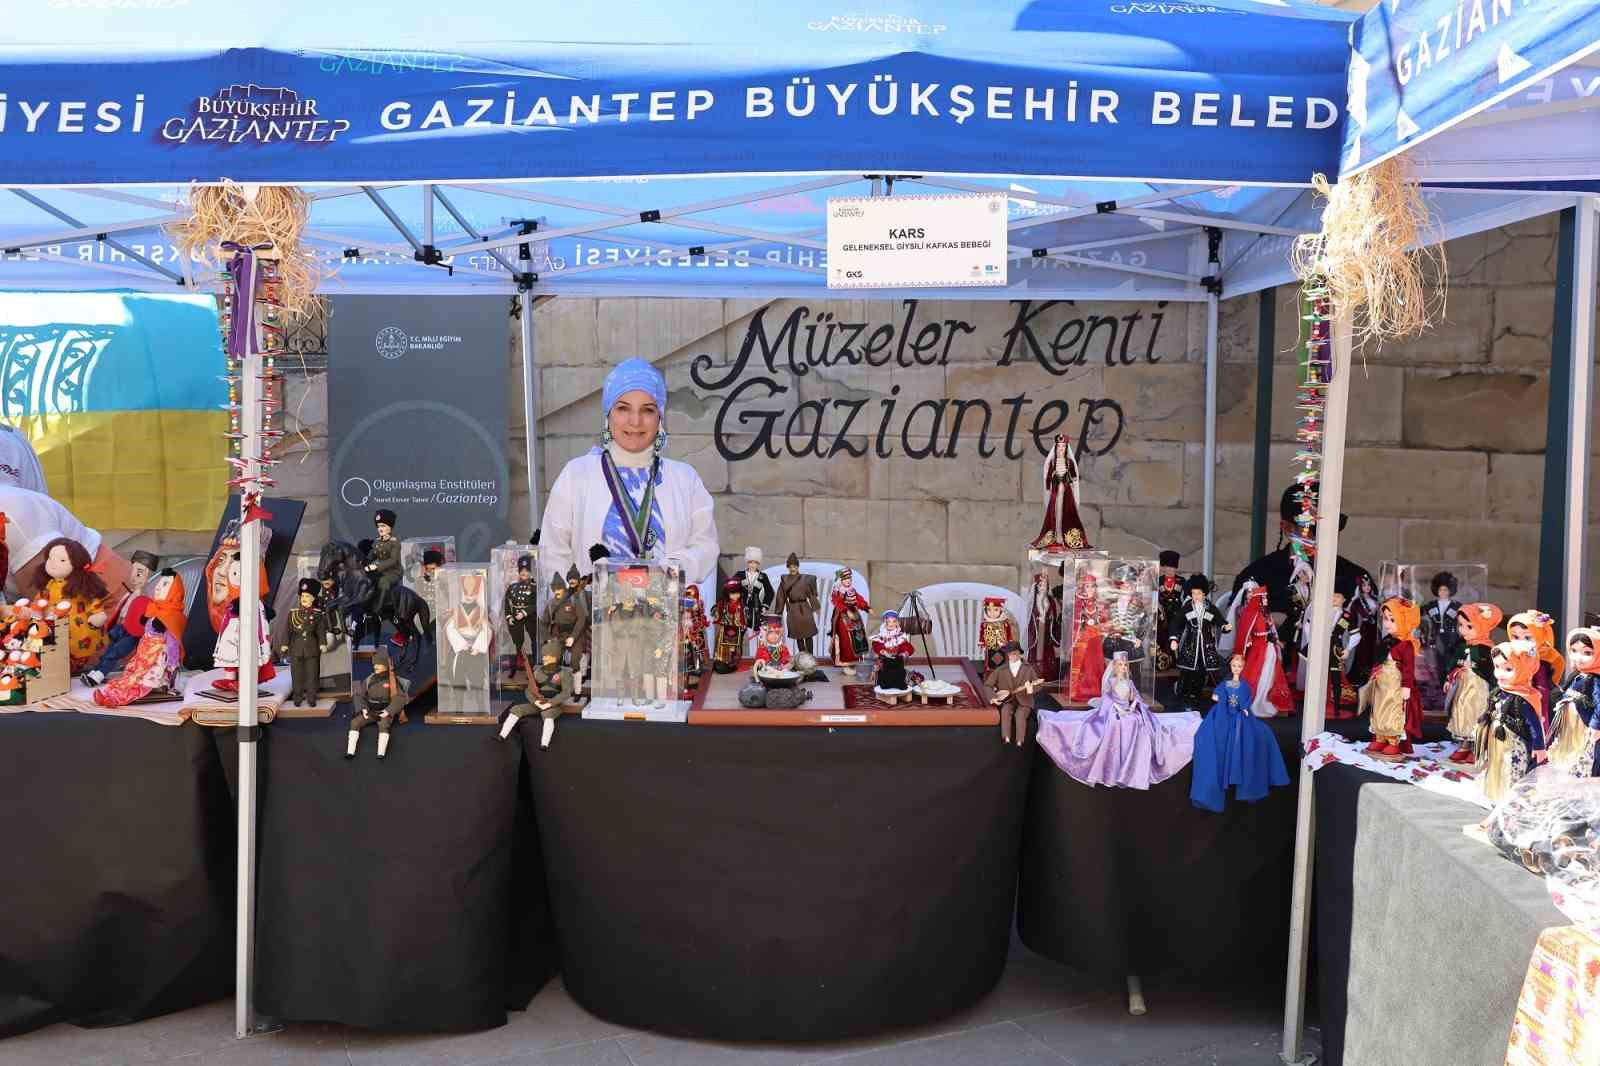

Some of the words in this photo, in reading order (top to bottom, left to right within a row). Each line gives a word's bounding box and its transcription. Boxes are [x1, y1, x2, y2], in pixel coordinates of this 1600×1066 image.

[199, 96, 320, 120] BÜYÜKŞEHİR
[380, 91, 714, 131] GAZİANTEP
[745, 74, 1121, 125] BÜYÜKŞEHİR
[1151, 91, 1338, 129] BELED
[162, 115, 350, 143] GAZİANTEP
[888, 228, 926, 239] KARS
[842, 243, 894, 252] GELENEKSEL
[926, 241, 959, 250] KAFKAS
[846, 270, 863, 279] GKS
[690, 300, 975, 391] Müzeler
[997, 299, 1168, 376] Kenti
[713, 376, 1125, 461] Gaziantep
[373, 479, 437, 492] Olgunlaşma
[440, 479, 495, 490] Enstitüleri
